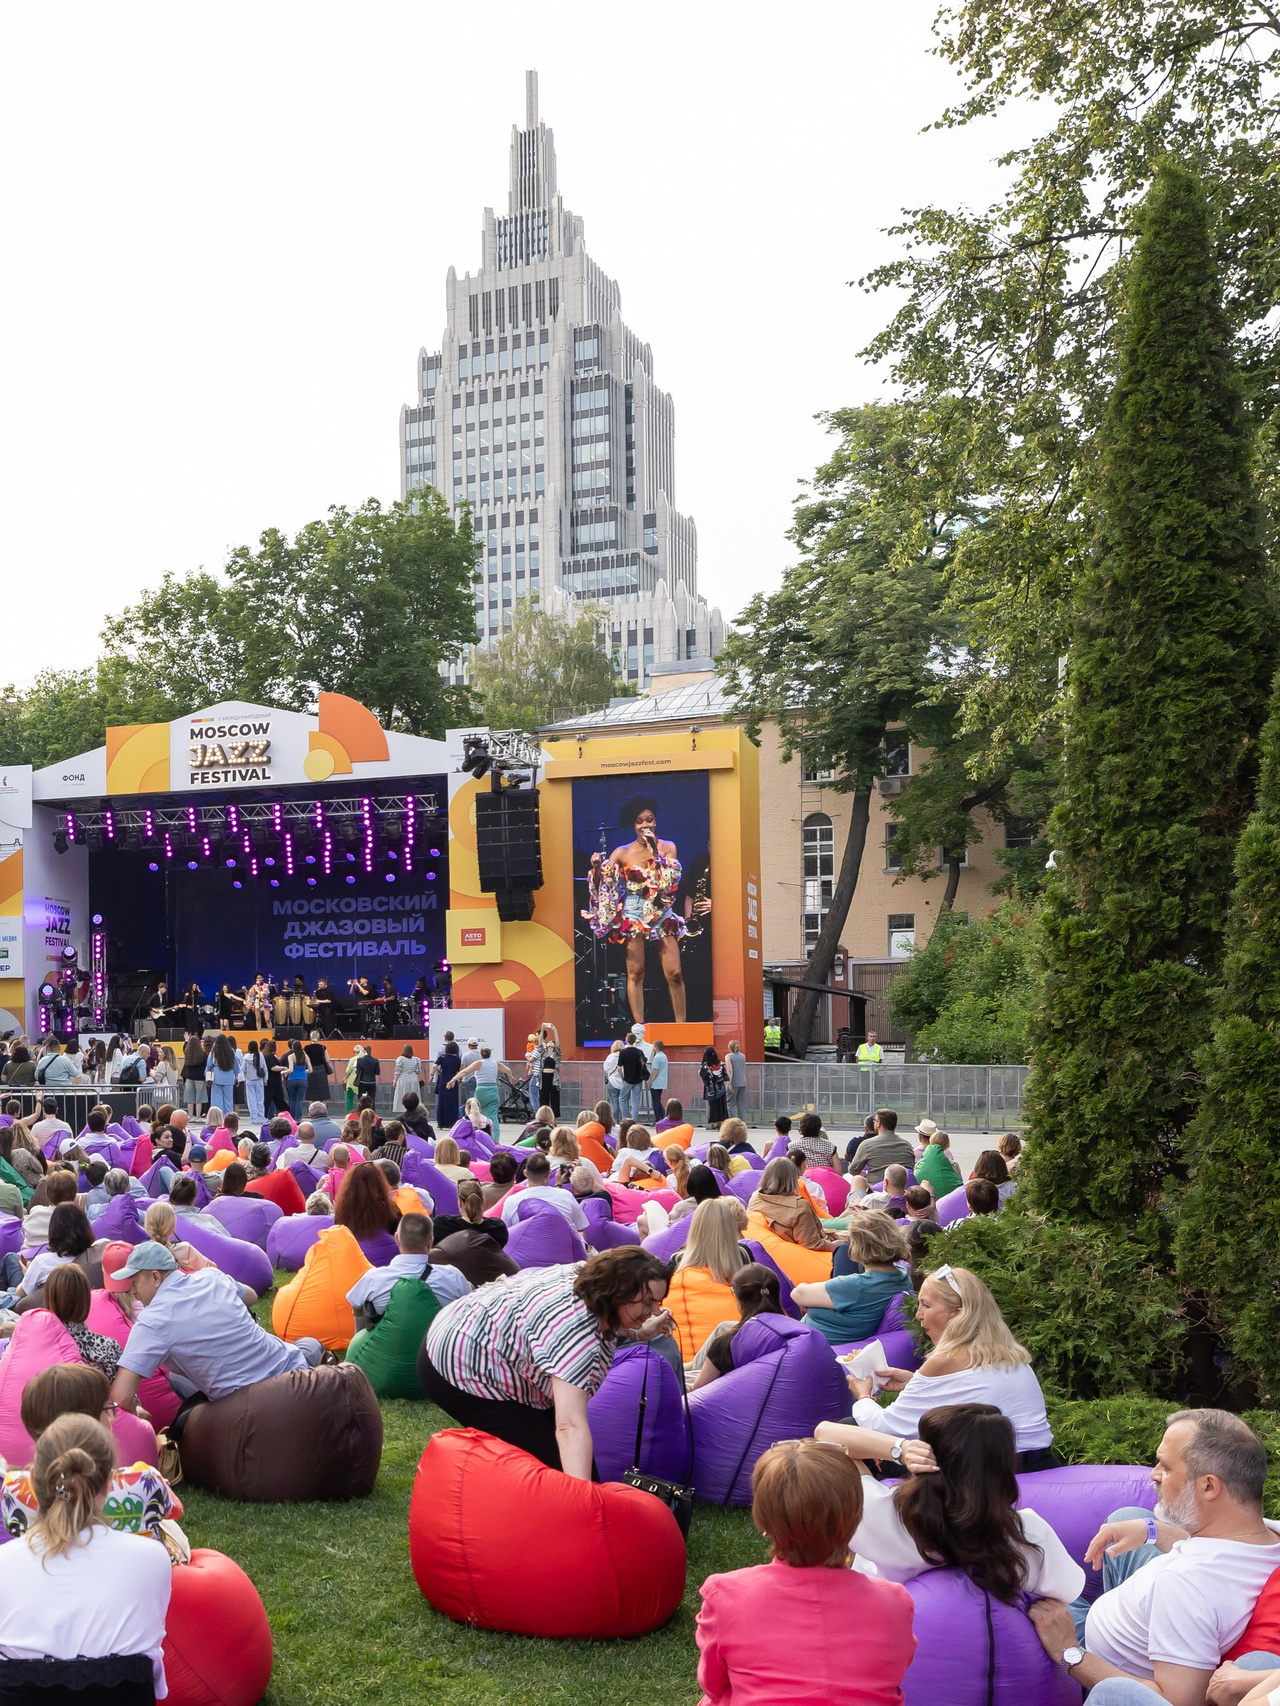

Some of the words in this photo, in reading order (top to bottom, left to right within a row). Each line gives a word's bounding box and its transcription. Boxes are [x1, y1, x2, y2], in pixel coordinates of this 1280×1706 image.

[190, 722, 271, 740] MOSCOW
[188, 740, 271, 768] JAZZ
[600, 758, 672, 769] moscowjazzfest.com
[62, 774, 85, 782] ФОНД
[190, 768, 271, 784] FESTIVAL
[45, 904, 70, 916] MOSCOW
[272, 890, 438, 916] МОСКОВСКИЙ
[45, 916, 71, 935] JAZZ
[283, 913, 425, 940] ДЖАЗОВЫЙ
[284, 940, 426, 959] ФЕСТИВАЛЬ
